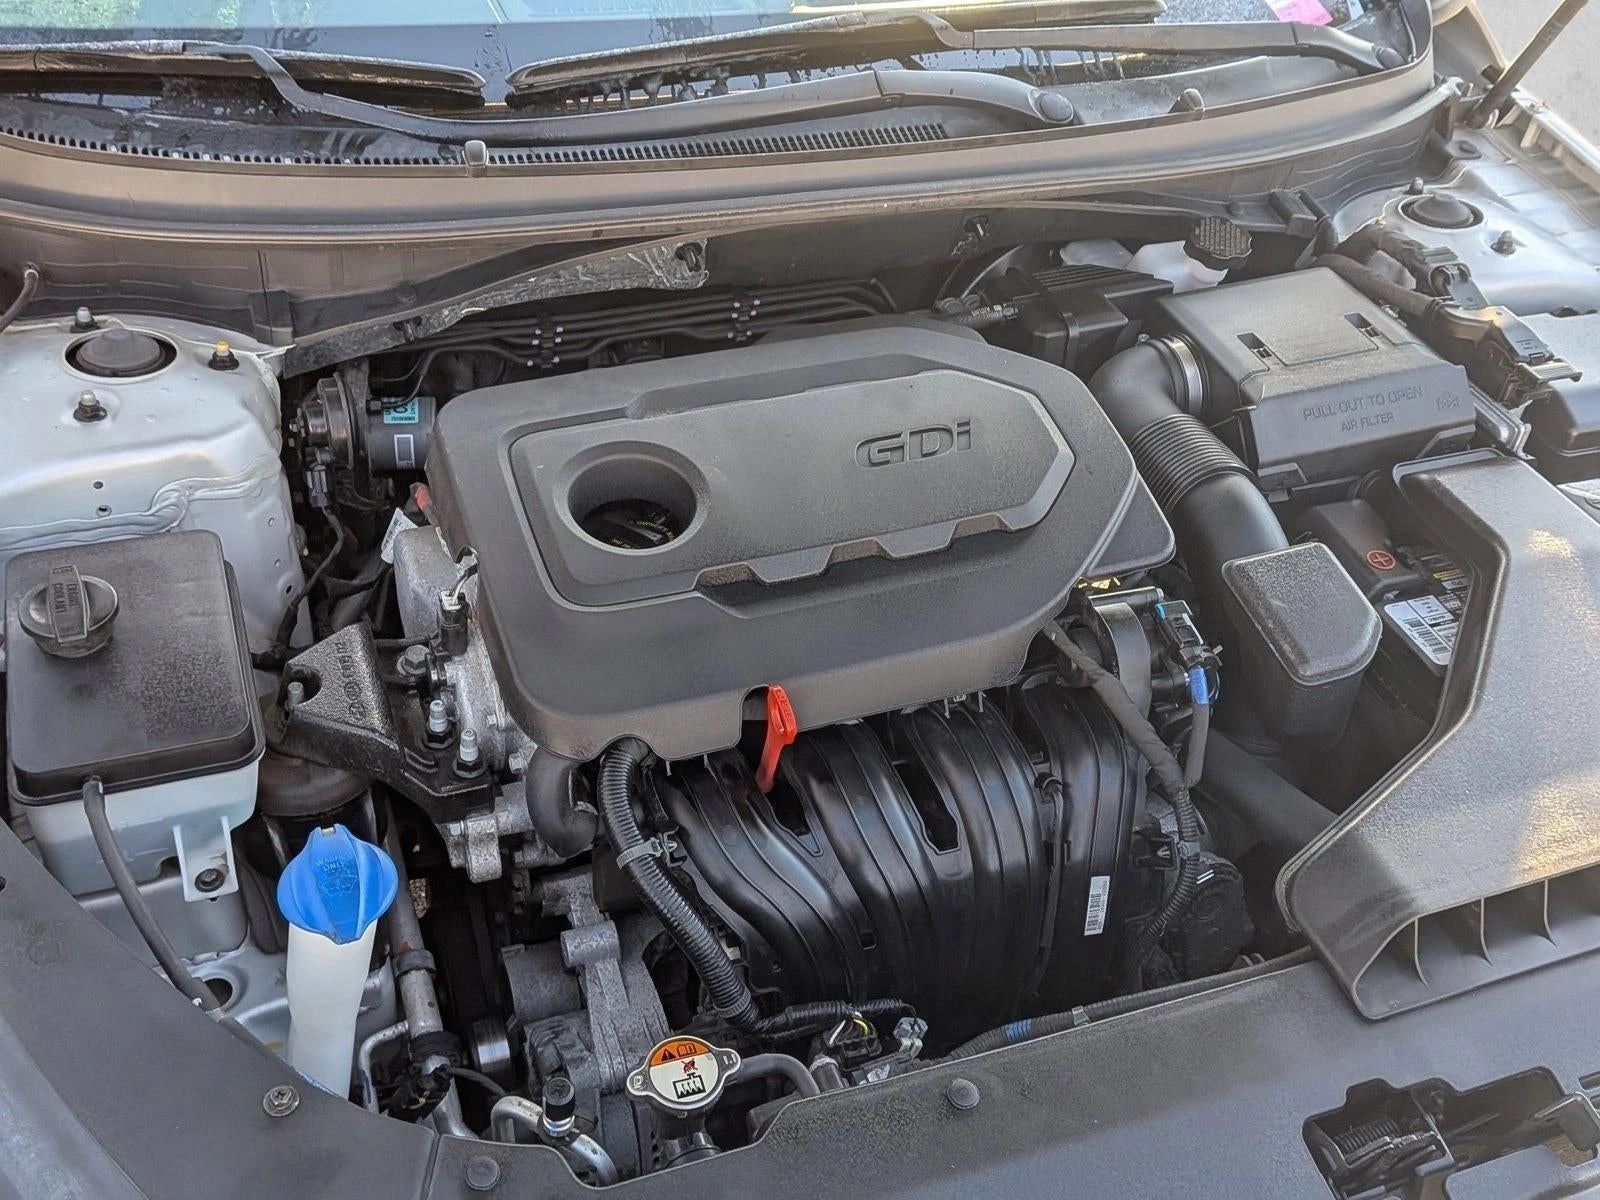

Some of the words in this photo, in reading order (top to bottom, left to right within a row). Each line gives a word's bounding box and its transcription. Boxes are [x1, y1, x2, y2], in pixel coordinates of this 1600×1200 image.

[1302, 405, 1336, 421] PULL
[1338, 399, 1365, 413] OUT
[1366, 394, 1386, 407] TO
[1388, 384, 1424, 403] OPEN
[1341, 418, 1358, 432] AIR
[1361, 412, 1394, 428] FILTER
[855, 417, 971, 469] GDi
[52, 582, 66, 613] COOLANT
[66, 583, 80, 607] ENGINE
[722, 1053, 737, 1065] 1.1
